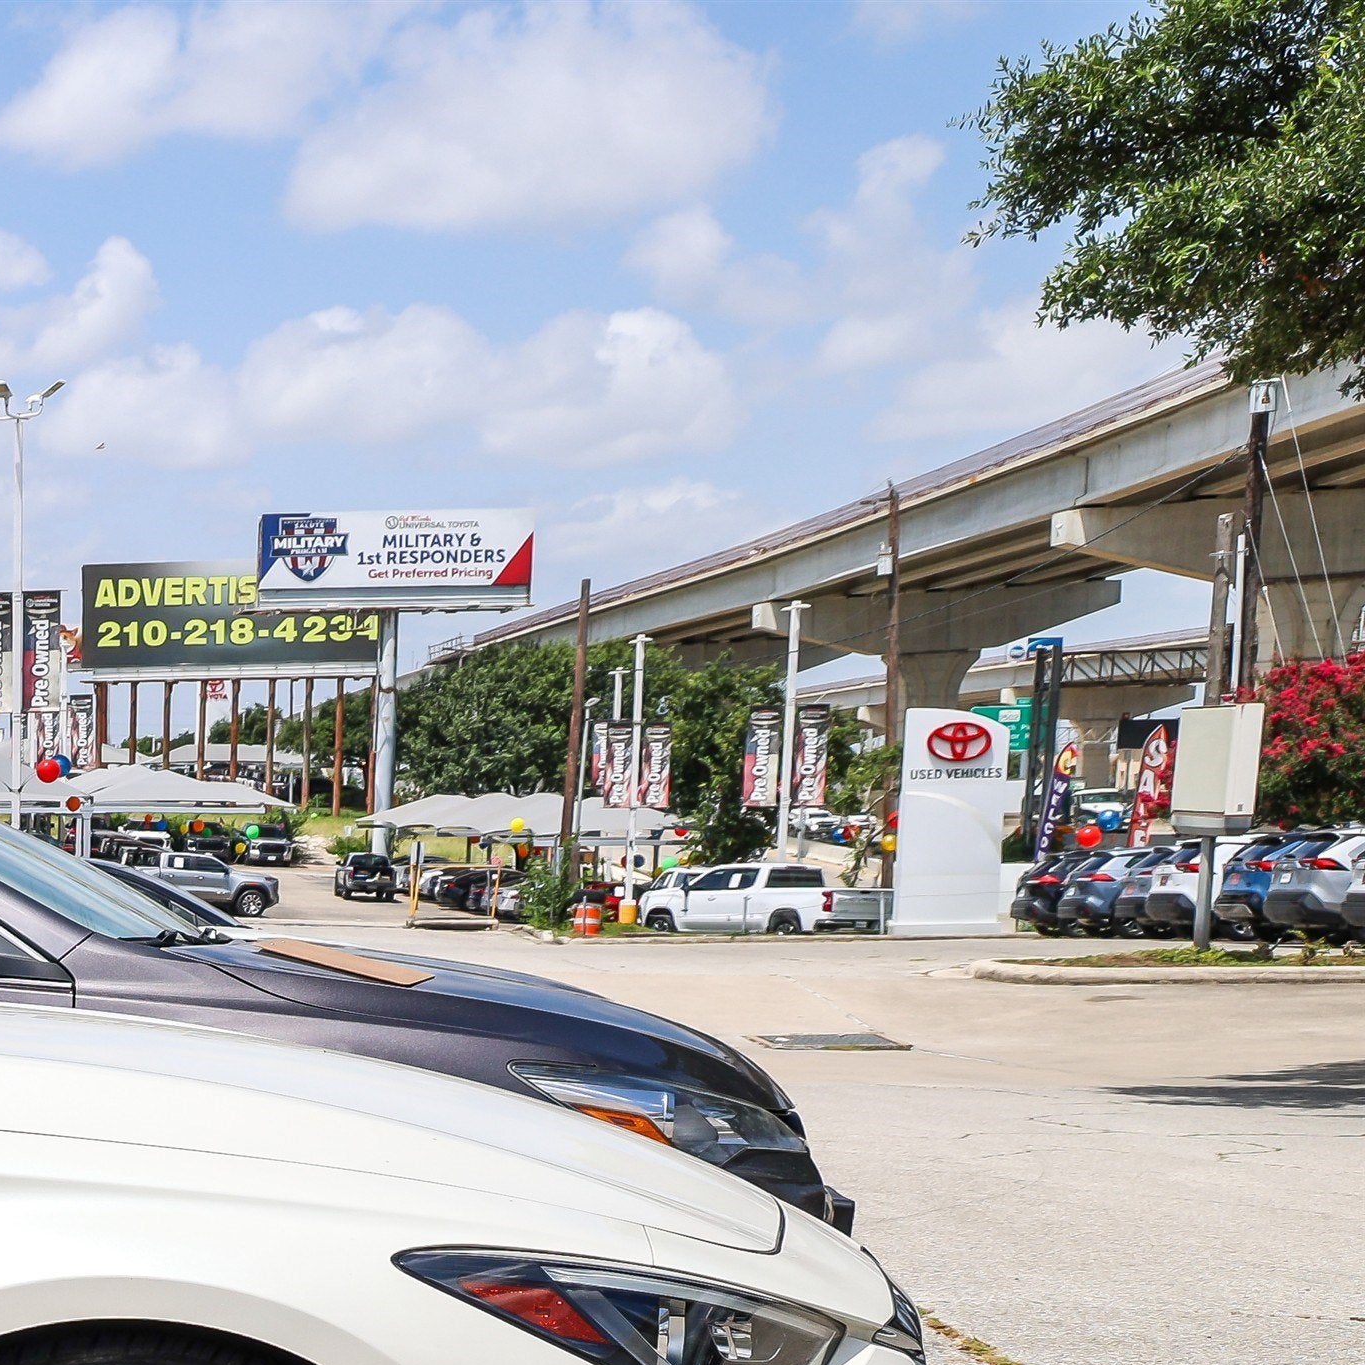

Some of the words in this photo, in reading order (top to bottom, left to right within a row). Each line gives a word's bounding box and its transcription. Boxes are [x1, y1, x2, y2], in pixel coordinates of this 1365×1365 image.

[399, 521, 446, 529] UNIVERSAL
[274, 535, 345, 550] MILITARY
[382, 533, 466, 548] MILITARY
[470, 532, 482, 547] &
[357, 552, 382, 566] 1st
[386, 549, 506, 565] RESPONDERS
[368, 569, 389, 579] Get
[392, 567, 449, 579] Preferred
[451, 567, 494, 580] Pricing
[95, 575, 257, 608] ADVERTIS
[97, 614, 380, 647] 210-218-4234
[31, 619, 50, 677] Owned
[31, 680, 49, 707] Pre
[610, 742, 625, 783] Owned
[647, 742, 663, 783] Owned
[751, 729, 770, 777] Owned
[800, 728, 818, 776] Owned
[910, 769, 942, 780] USED
[946, 768, 1003, 780] VEHICLES
[609, 784, 623, 804] Pre
[646, 784, 660, 804] Pre
[750, 777, 767, 801] Pre
[798, 777, 815, 801] Pre
